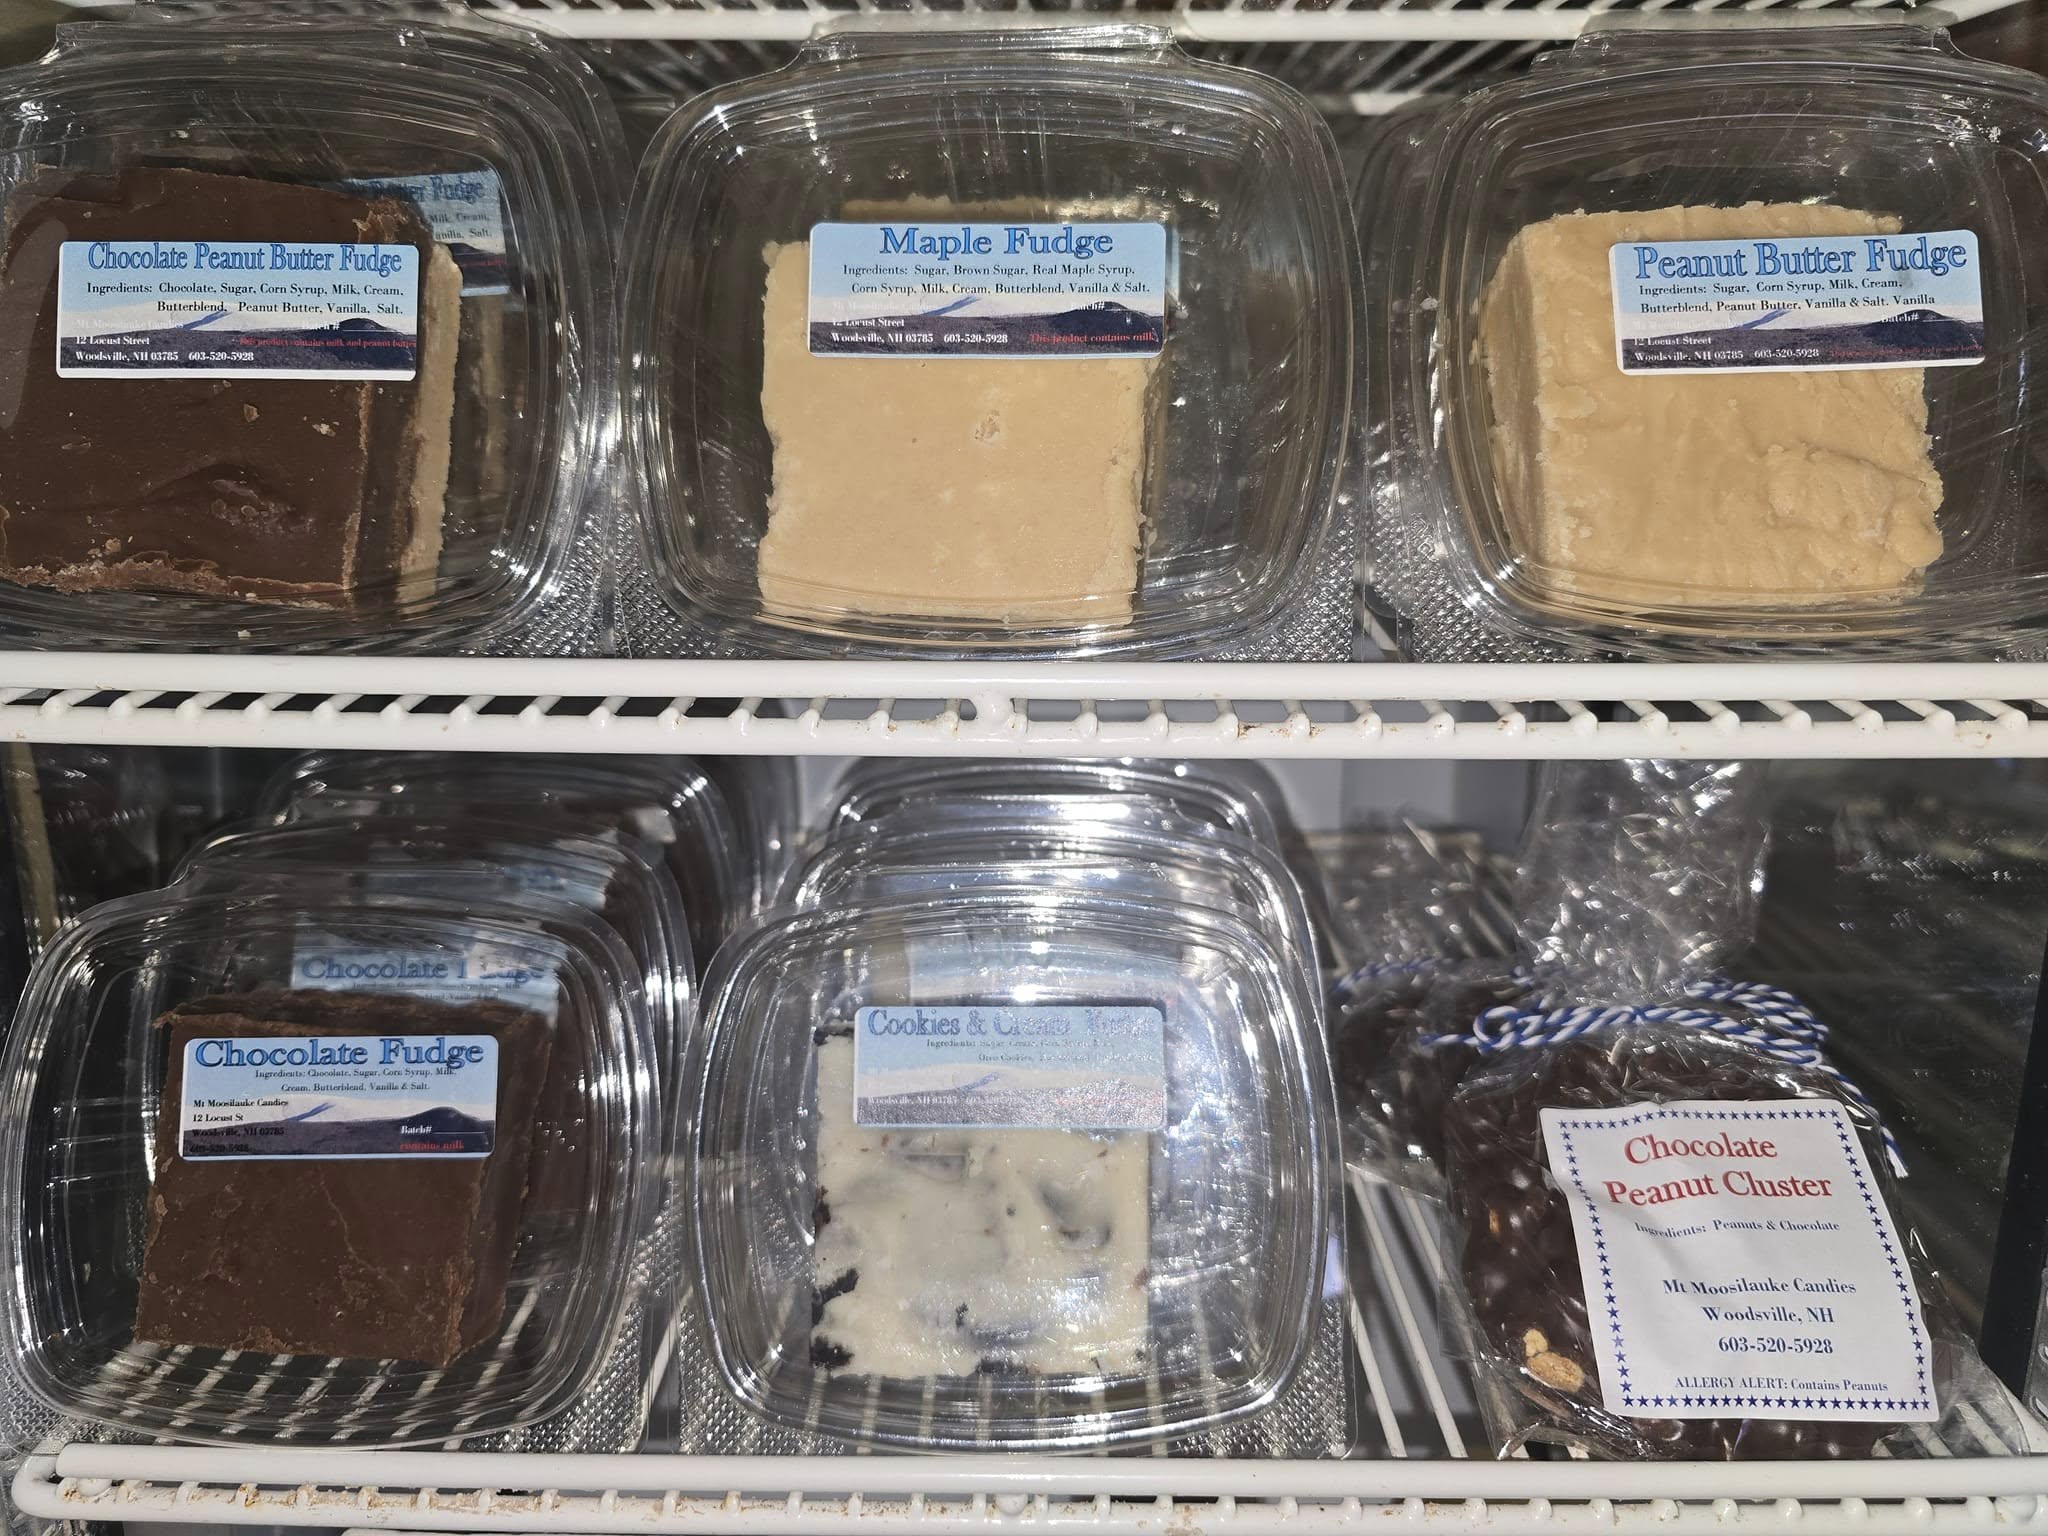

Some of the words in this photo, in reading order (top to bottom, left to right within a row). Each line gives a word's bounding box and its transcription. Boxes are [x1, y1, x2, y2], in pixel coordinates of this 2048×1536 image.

[879, 226, 992, 261] Maple
[1003, 226, 1113, 260] Fudge
[88, 242, 188, 270] Chocolate
[194, 242, 265, 271] Peanut
[270, 243, 334, 271] Butter
[339, 244, 402, 278] Fudge
[1633, 246, 1748, 279] Peanut
[1753, 242, 1856, 276] Butter
[1863, 236, 1967, 276] Fudge
[843, 264, 908, 276] Ingredients:
[914, 264, 949, 276] Sugar,
[954, 265, 990, 275] Brown
[1033, 264, 1057, 275] Real
[1061, 264, 1095, 277] Maple
[87, 282, 152, 296] Ingredients:
[159, 282, 217, 294] Chocolate,
[221, 283, 256, 296] Sugar,
[260, 283, 287, 294] Corn
[290, 283, 327, 297] Syrup,
[332, 284, 360, 295] Milk,
[851, 283, 877, 294] Corn
[952, 283, 991, 295] Cream,
[995, 283, 1065, 295] Butterblend,
[1068, 282, 1109, 293] Vanilla
[1111, 282, 1121, 293] &
[1124, 282, 1150, 293] Salt.
[1639, 285, 1707, 297] Ingredients:
[1756, 282, 1784, 293] Corn
[157, 301, 227, 312] Butterblend,
[238, 301, 279, 313] Peanut
[282, 302, 323, 314] Butter,
[377, 303, 403, 315] Salt.
[1716, 301, 1756, 312] Peanut
[1805, 297, 1846, 309] Vanilla
[1849, 297, 1860, 308] &
[1893, 294, 1935, 305] Vanilla
[878, 317, 905, 327] Street
[75, 336, 87, 345] 12
[89, 336, 121, 345] Locust
[123, 335, 150, 345] Street
[831, 333, 884, 344] Woodsville,
[887, 333, 902, 343] NH
[905, 333, 934, 343] 03785
[943, 333, 1008, 343] 603-520-5928
[1647, 336, 1680, 346] Locust
[1682, 335, 1712, 345] Street
[75, 351, 130, 362] Woodsville,
[133, 351, 148, 361] NH
[151, 351, 179, 361] 03785
[188, 352, 254, 361] 603-520-5928
[1634, 351, 1691, 361] Woodsville,
[1694, 350, 1712, 360] NH
[1714, 350, 1744, 360] 03785
[1754, 348, 1820, 359] 603-520-5928
[302, 955, 449, 979] Chocolate
[867, 1008, 961, 1036] Cookies
[966, 1009, 988, 1036] &
[195, 1038, 369, 1067] Chocolate
[378, 1036, 484, 1070] Fudge
[255, 1069, 306, 1080] Ingredients:
[383, 1067, 402, 1076] Corn
[369, 1082, 399, 1091] Vanilla
[401, 1082, 408, 1090] &
[193, 1099, 205, 1107] Mt
[208, 1098, 254, 1108] Moosilauke
[256, 1098, 289, 1107] Candies
[192, 1114, 203, 1122] 12
[205, 1113, 233, 1122] Locust
[234, 1113, 244, 1122] St
[401, 1124, 433, 1134] Batch#
[1623, 1131, 1778, 1164] Chocolate
[1602, 1174, 1719, 1206] Peanut
[1721, 1169, 1833, 1198] Cluster
[1633, 1221, 1706, 1239] Ingredients:
[1712, 1218, 1763, 1231] Peanuts
[1766, 1220, 1777, 1231] &
[1779, 1219, 1840, 1232] Chocolate
[1662, 1278, 1688, 1294] Mt
[1690, 1277, 1790, 1295] Moosilauke
[1793, 1277, 1857, 1294] Candies
[1701, 1306, 1803, 1325] Woodsville,
[1806, 1306, 1836, 1323] NH
[1718, 1336, 1834, 1354] 603-520-5928
[1675, 1376, 1738, 1389] ALLERGY
[1739, 1376, 1788, 1390] ALERT:
[1790, 1378, 1840, 1391] Contains
[1843, 1378, 1889, 1391] Peanuts
